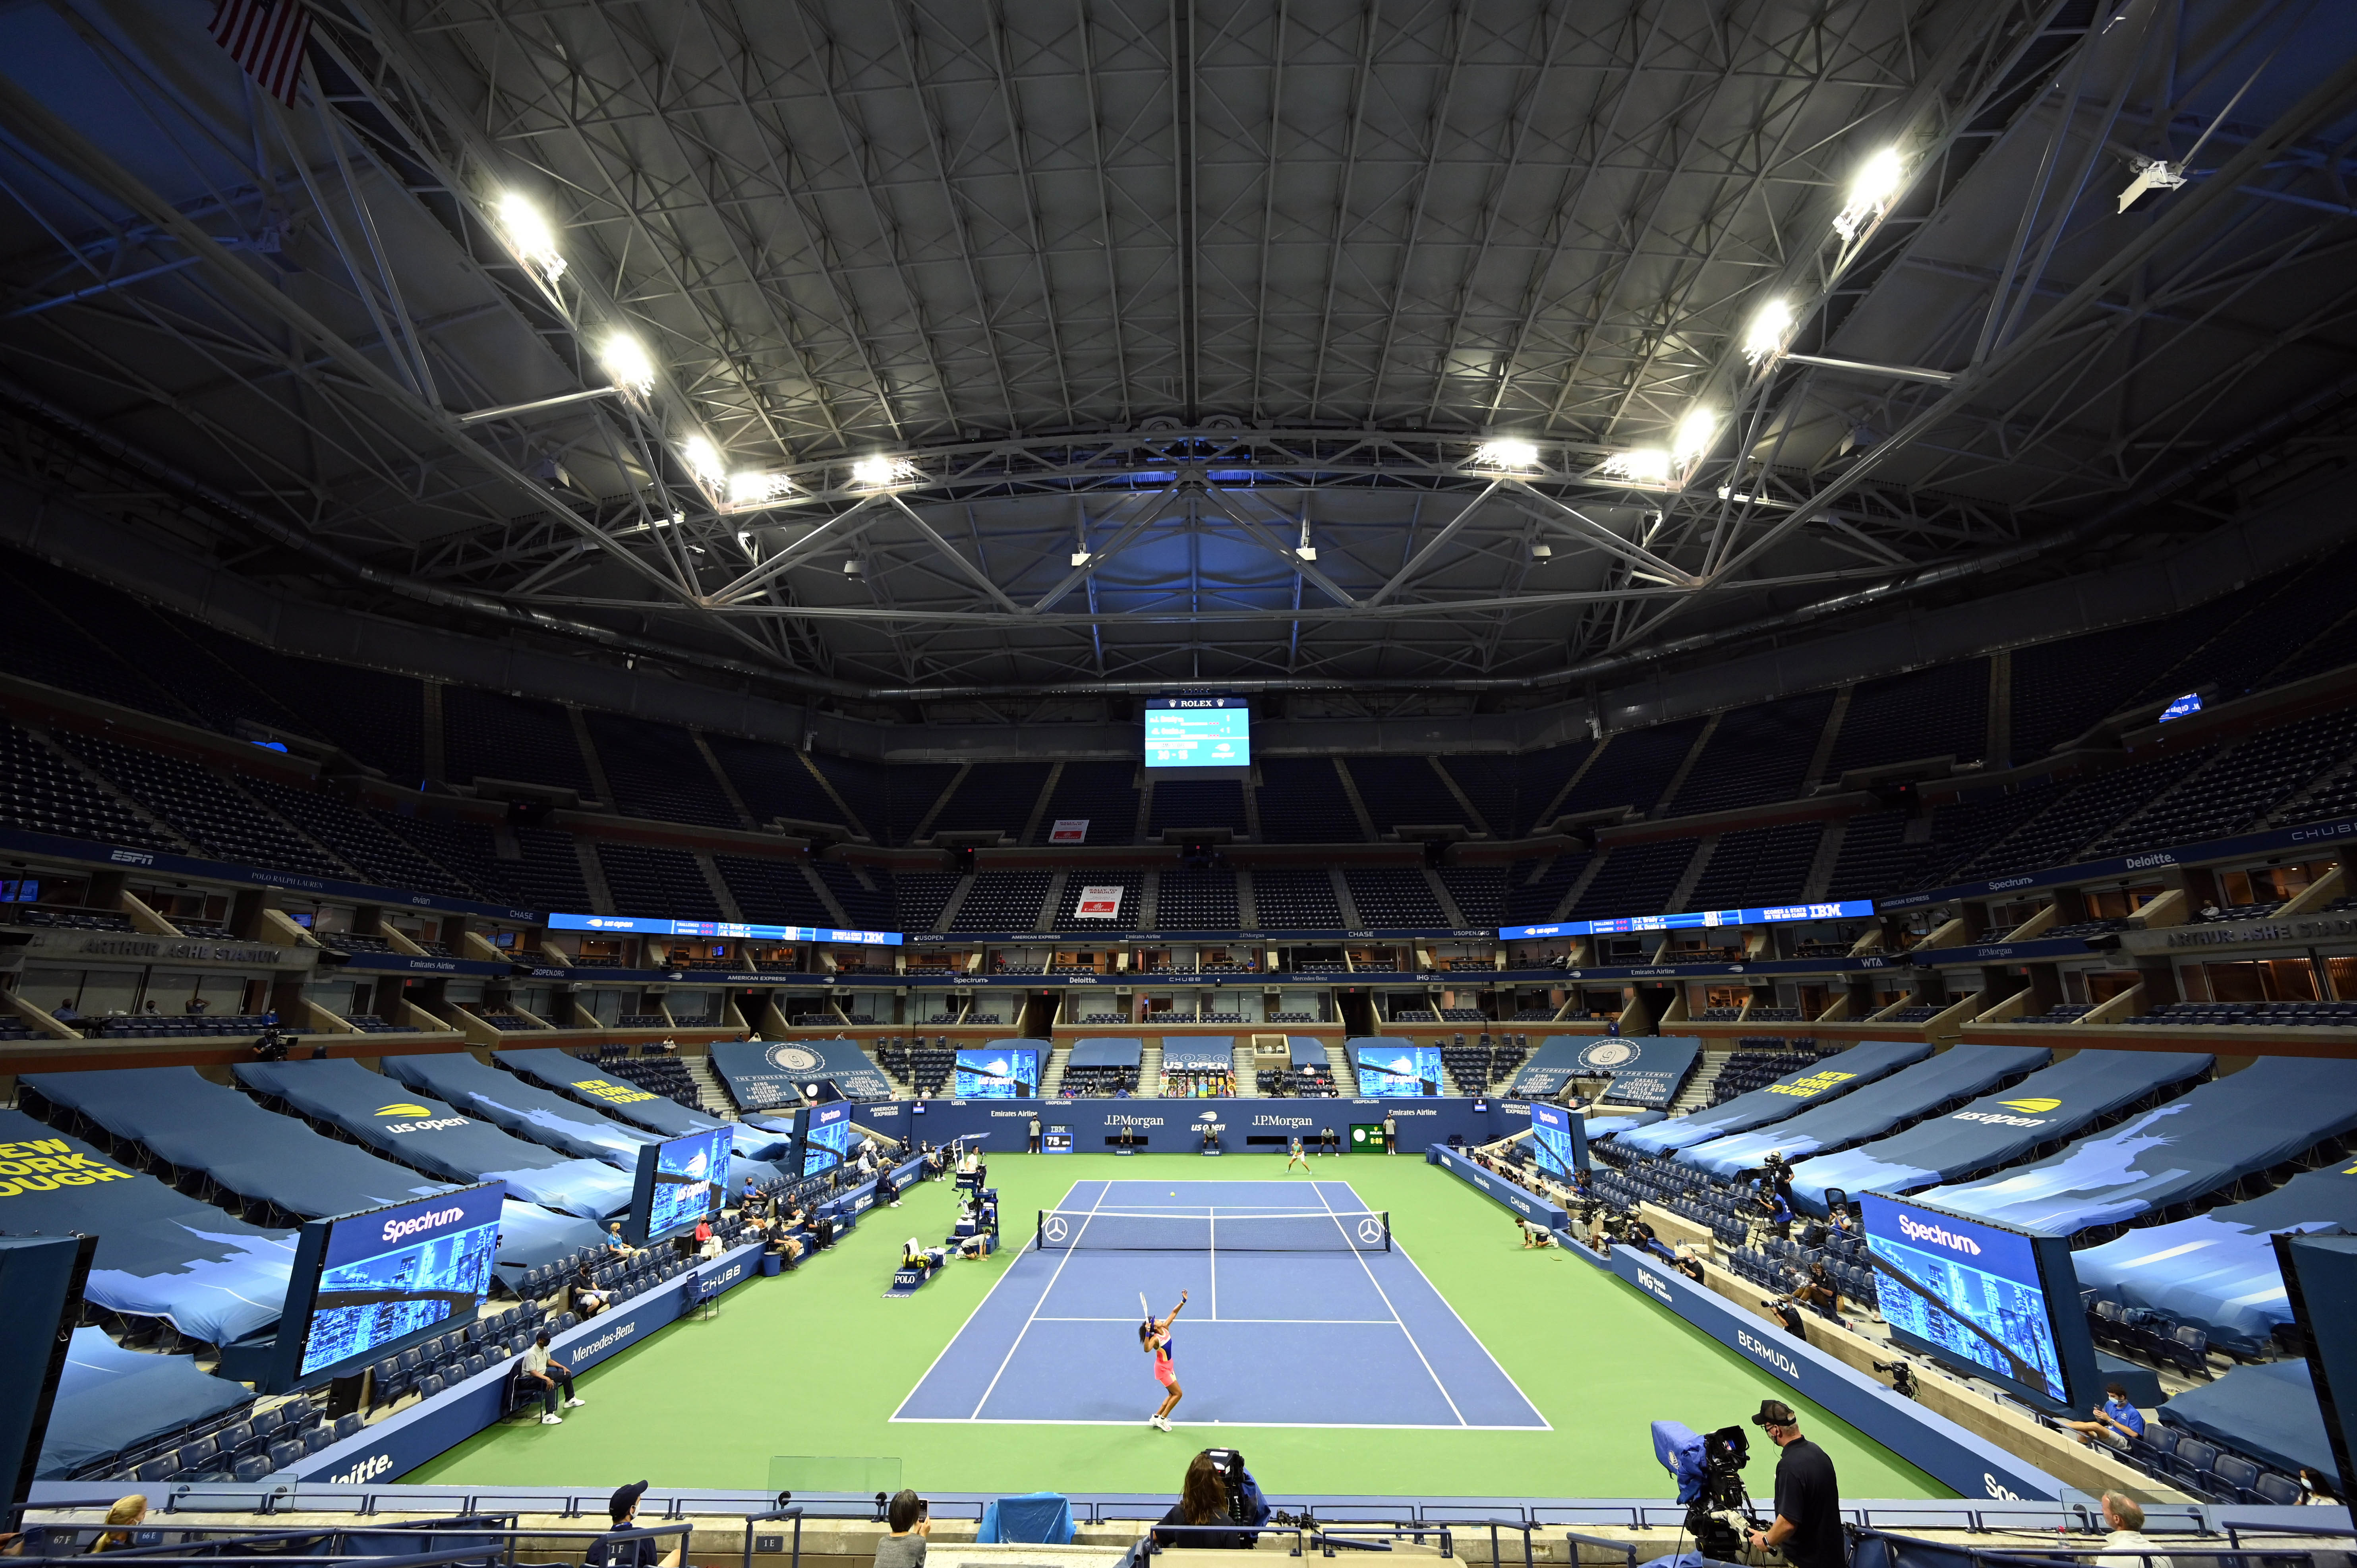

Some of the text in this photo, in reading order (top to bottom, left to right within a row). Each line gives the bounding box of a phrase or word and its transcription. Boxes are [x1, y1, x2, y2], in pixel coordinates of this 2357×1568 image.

[2291, 822, 2357, 841] CHUB
[111, 850, 154, 865] ESPN
[2126, 853, 2175, 869] Deloitte.
[252, 872, 323, 888] POLO RALPH LAUREN
[1989, 876, 2030, 891] Spectrum
[412, 895, 430, 905] evian
[510, 910, 533, 920] CHASE
[1809, 904, 1841, 918] IBM
[864, 932, 884, 943] IBM
[2167, 925, 2292, 947] ARTHUR ASHE
[82, 938, 280, 964] ARTHUR ASHE STADIUM
[410, 960, 455, 971] Emirates Airline
[1861, 957, 1883, 968] WTA
[788, 1054, 804, 1067] 9
[1164, 1053, 1228, 1062] 2020
[1599, 1050, 1616, 1062] 9
[978, 1077, 1014, 1087] us open
[1383, 1074, 1419, 1085] us open
[1790, 1078, 1840, 1090] YORK
[1811, 1071, 1858, 1083] NEW
[570, 1079, 611, 1090] NEW
[586, 1086, 636, 1097] YORK
[1764, 1084, 1821, 1098] TOUGH
[603, 1092, 660, 1104] TOUGH
[747, 1091, 787, 1100] BARTKOWICZ
[821, 1110, 840, 1123] Spectrum
[1104, 1115, 1164, 1128] J.P.Morgan
[1252, 1116, 1313, 1129] J.P.Morgan
[1539, 1110, 1556, 1124] Spectrum
[1952, 1111, 2046, 1127] us open
[386, 1117, 470, 1134] us open
[1047, 1137, 1060, 1145] 75
[0, 1139, 72, 1159] EW
[0, 1153, 106, 1175] ORK
[896, 1173, 912, 1187] BERMUDA
[676, 1179, 710, 1202] us open
[855, 1197, 864, 1210] IHG
[1510, 1195, 1530, 1213] CHUBB
[382, 1207, 458, 1243] Spectrum
[1899, 1214, 1976, 1255] Spectrum
[702, 1264, 741, 1292] CHUBB
[1638, 1268, 1666, 1290] IHG Hotels
[1658, 1288, 1672, 1303] Resorts
[571, 1322, 634, 1365] Mercedes-Benz
[1738, 1330, 1799, 1379] BERMUDA
[54, 1535, 71, 1544] 67 F
[611, 1545, 624, 1554] 1 F
